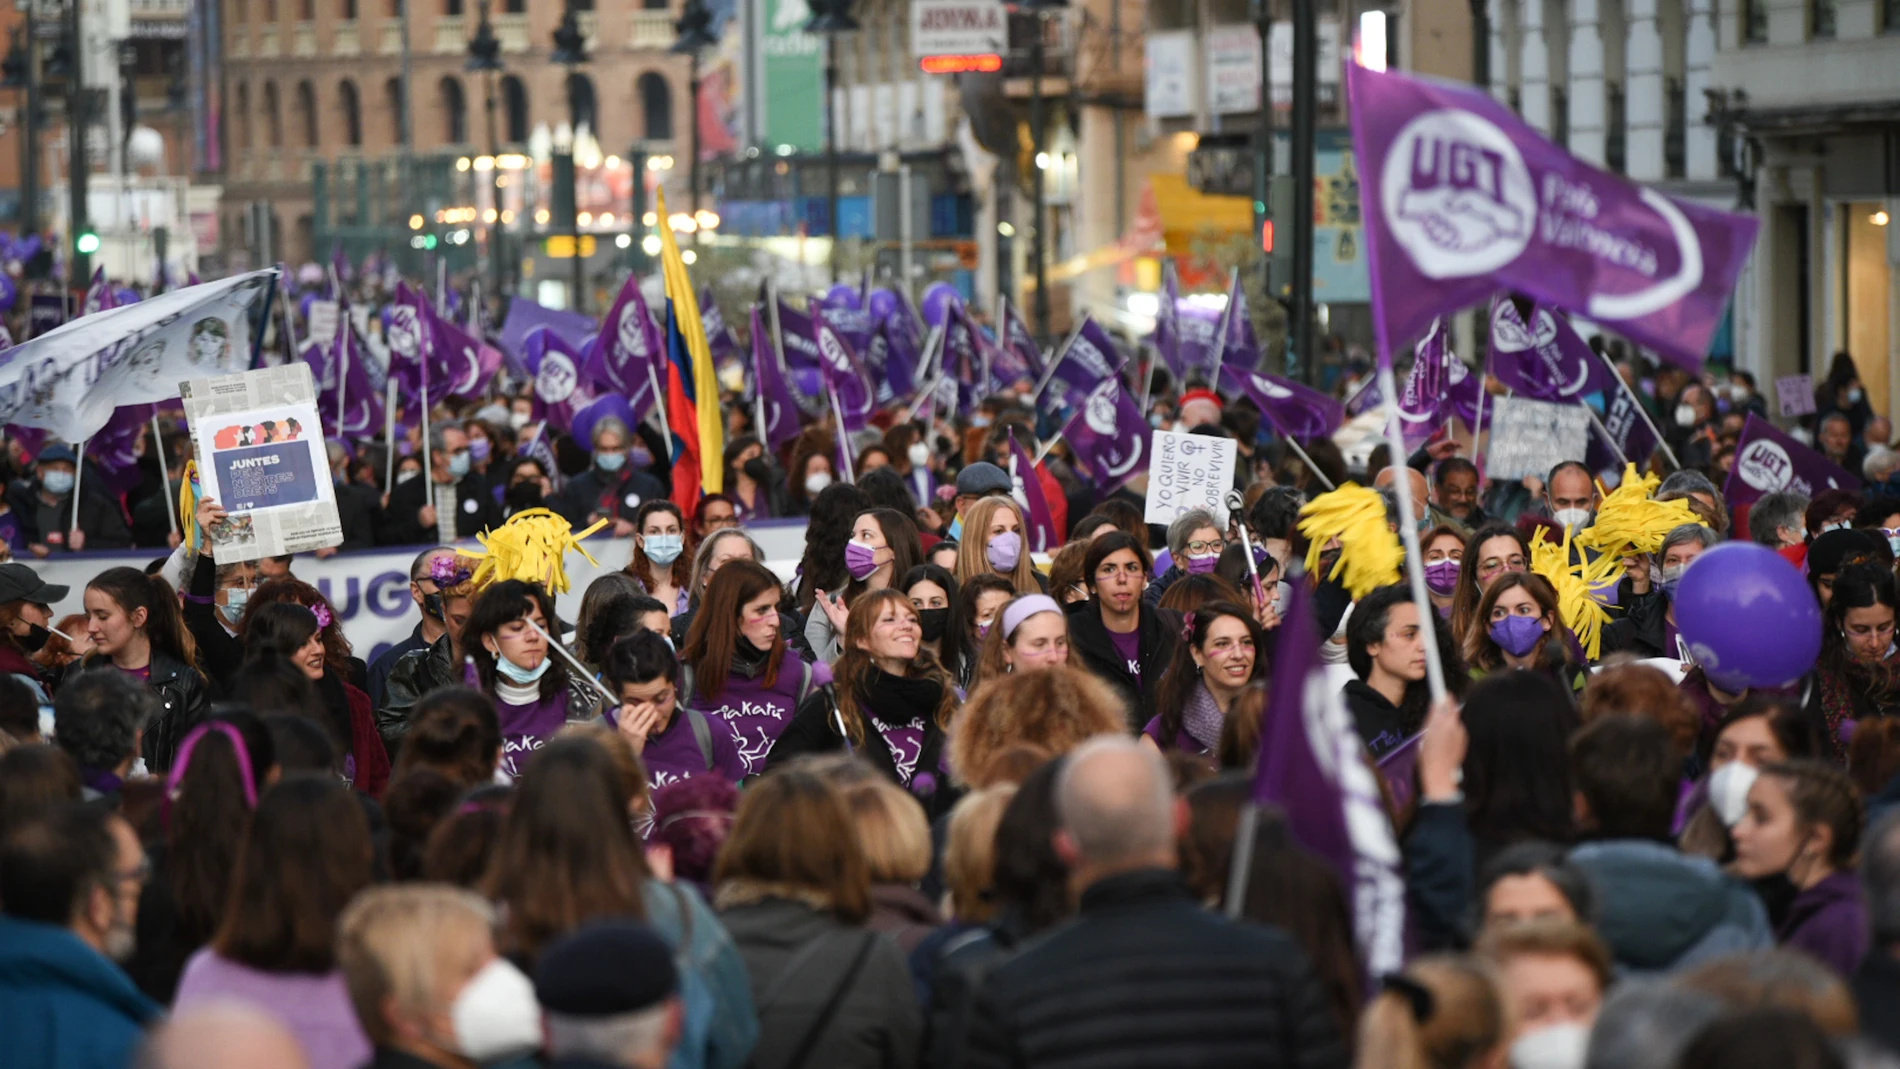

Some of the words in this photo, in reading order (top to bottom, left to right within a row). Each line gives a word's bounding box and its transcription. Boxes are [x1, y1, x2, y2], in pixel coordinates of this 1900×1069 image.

[1411, 135, 1505, 203] UGT
[229, 455, 280, 470] JUNTES
[1750, 444, 1788, 478] UGT
[230, 467, 264, 480] PELS
[231, 472, 295, 490] NOSTRES
[1175, 461, 1191, 495] VIVIR
[1192, 468, 1205, 486] NO
[233, 484, 278, 498] DRETS
